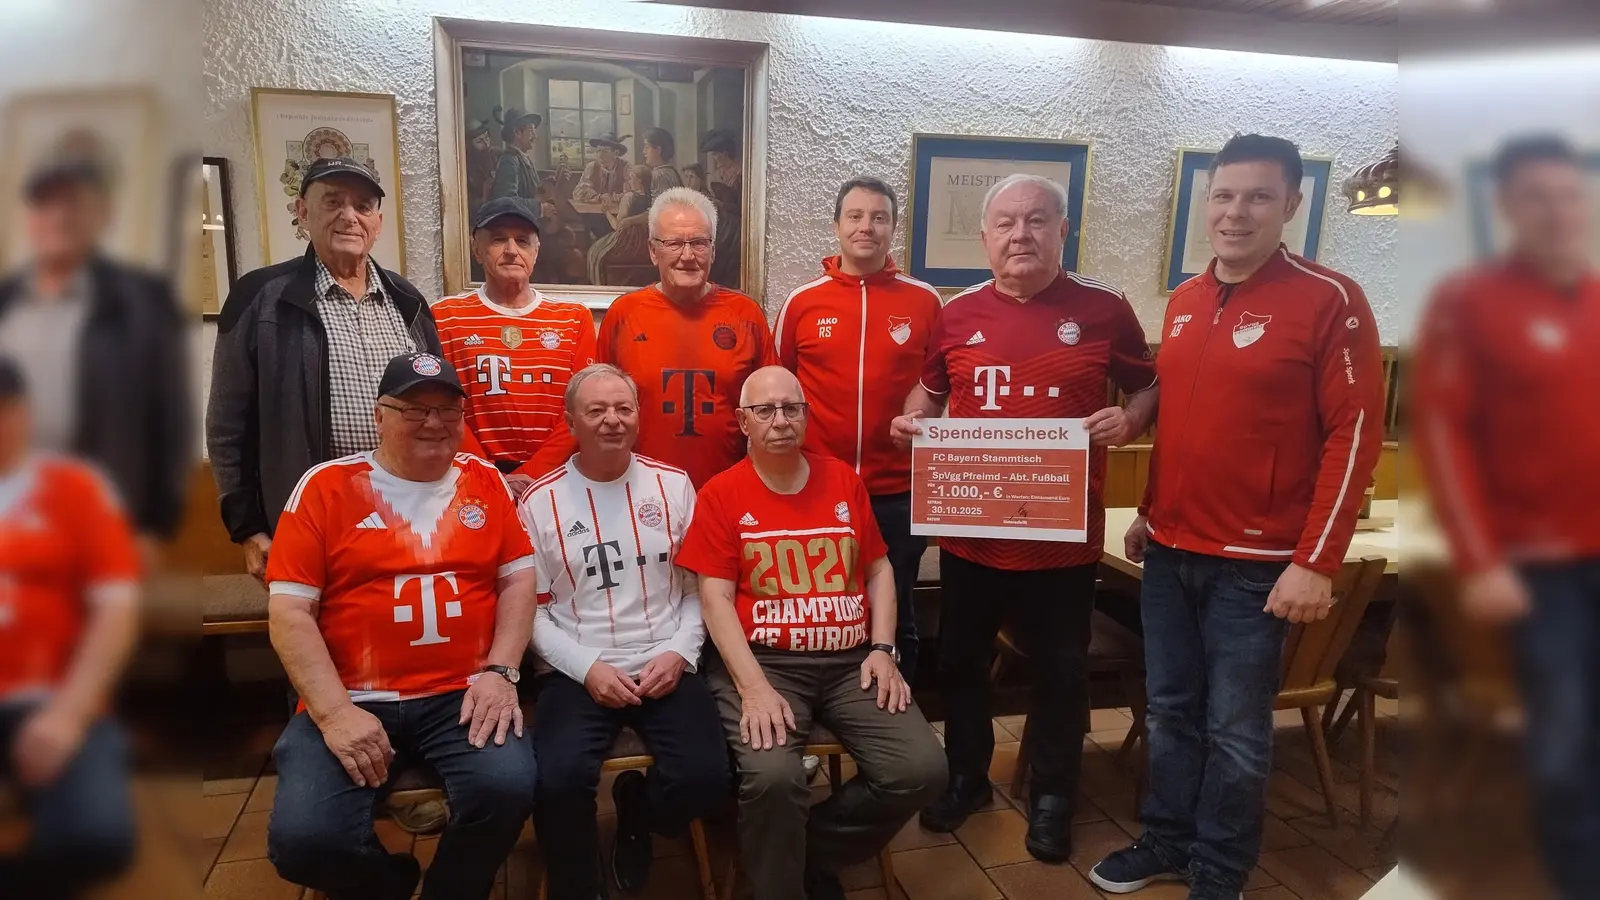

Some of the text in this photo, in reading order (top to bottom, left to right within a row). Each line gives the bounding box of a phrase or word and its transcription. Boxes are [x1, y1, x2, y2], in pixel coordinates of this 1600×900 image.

[1173, 314, 1192, 324] JAKO
[819, 326, 832, 338] RS
[1342, 348, 1351, 365] Sport
[476, 354, 511, 396] T
[974, 365, 1010, 410] T
[662, 369, 715, 437] T
[928, 426, 1068, 442] Spendenscheck
[948, 454, 980, 463] Bayern
[982, 454, 1042, 463] Stammtisch
[932, 472, 961, 482] SpVgg
[963, 472, 1000, 481] Pfreimd
[1009, 473, 1029, 481] Abt.
[1032, 473, 1070, 482] Fußball
[932, 485, 990, 499] -1.000,-
[993, 486, 1003, 498] €
[932, 506, 982, 515] 30.10.2025
[567, 528, 590, 538] adidas
[582, 540, 624, 590] T
[744, 536, 860, 596] 2020
[393, 571, 462, 647] T
[752, 594, 864, 624] CHAMPIONS
[750, 627, 781, 649] OF
